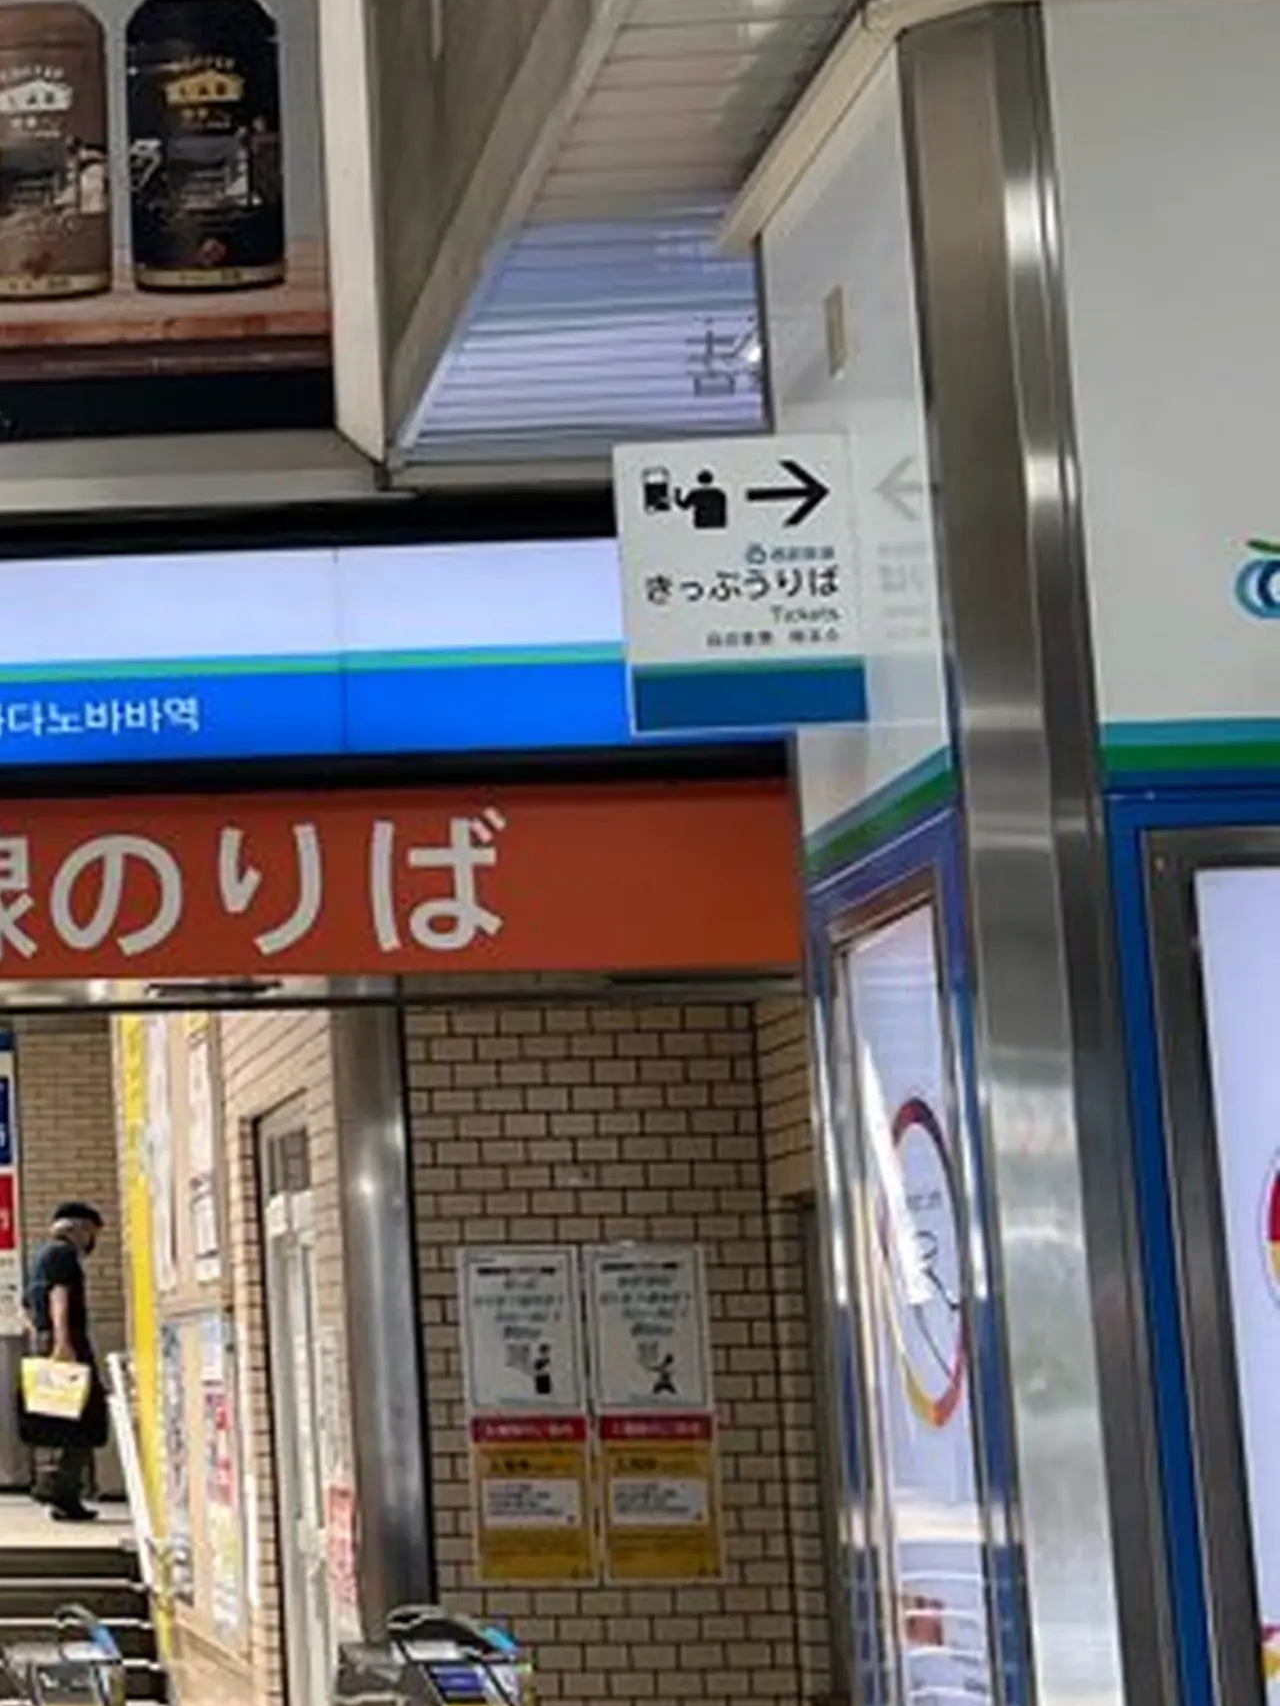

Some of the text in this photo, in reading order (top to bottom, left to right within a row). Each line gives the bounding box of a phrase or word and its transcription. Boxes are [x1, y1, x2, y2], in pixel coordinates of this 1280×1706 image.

[645, 563, 840, 606] きっぷうりば
[770, 604, 841, 623] Tickets
